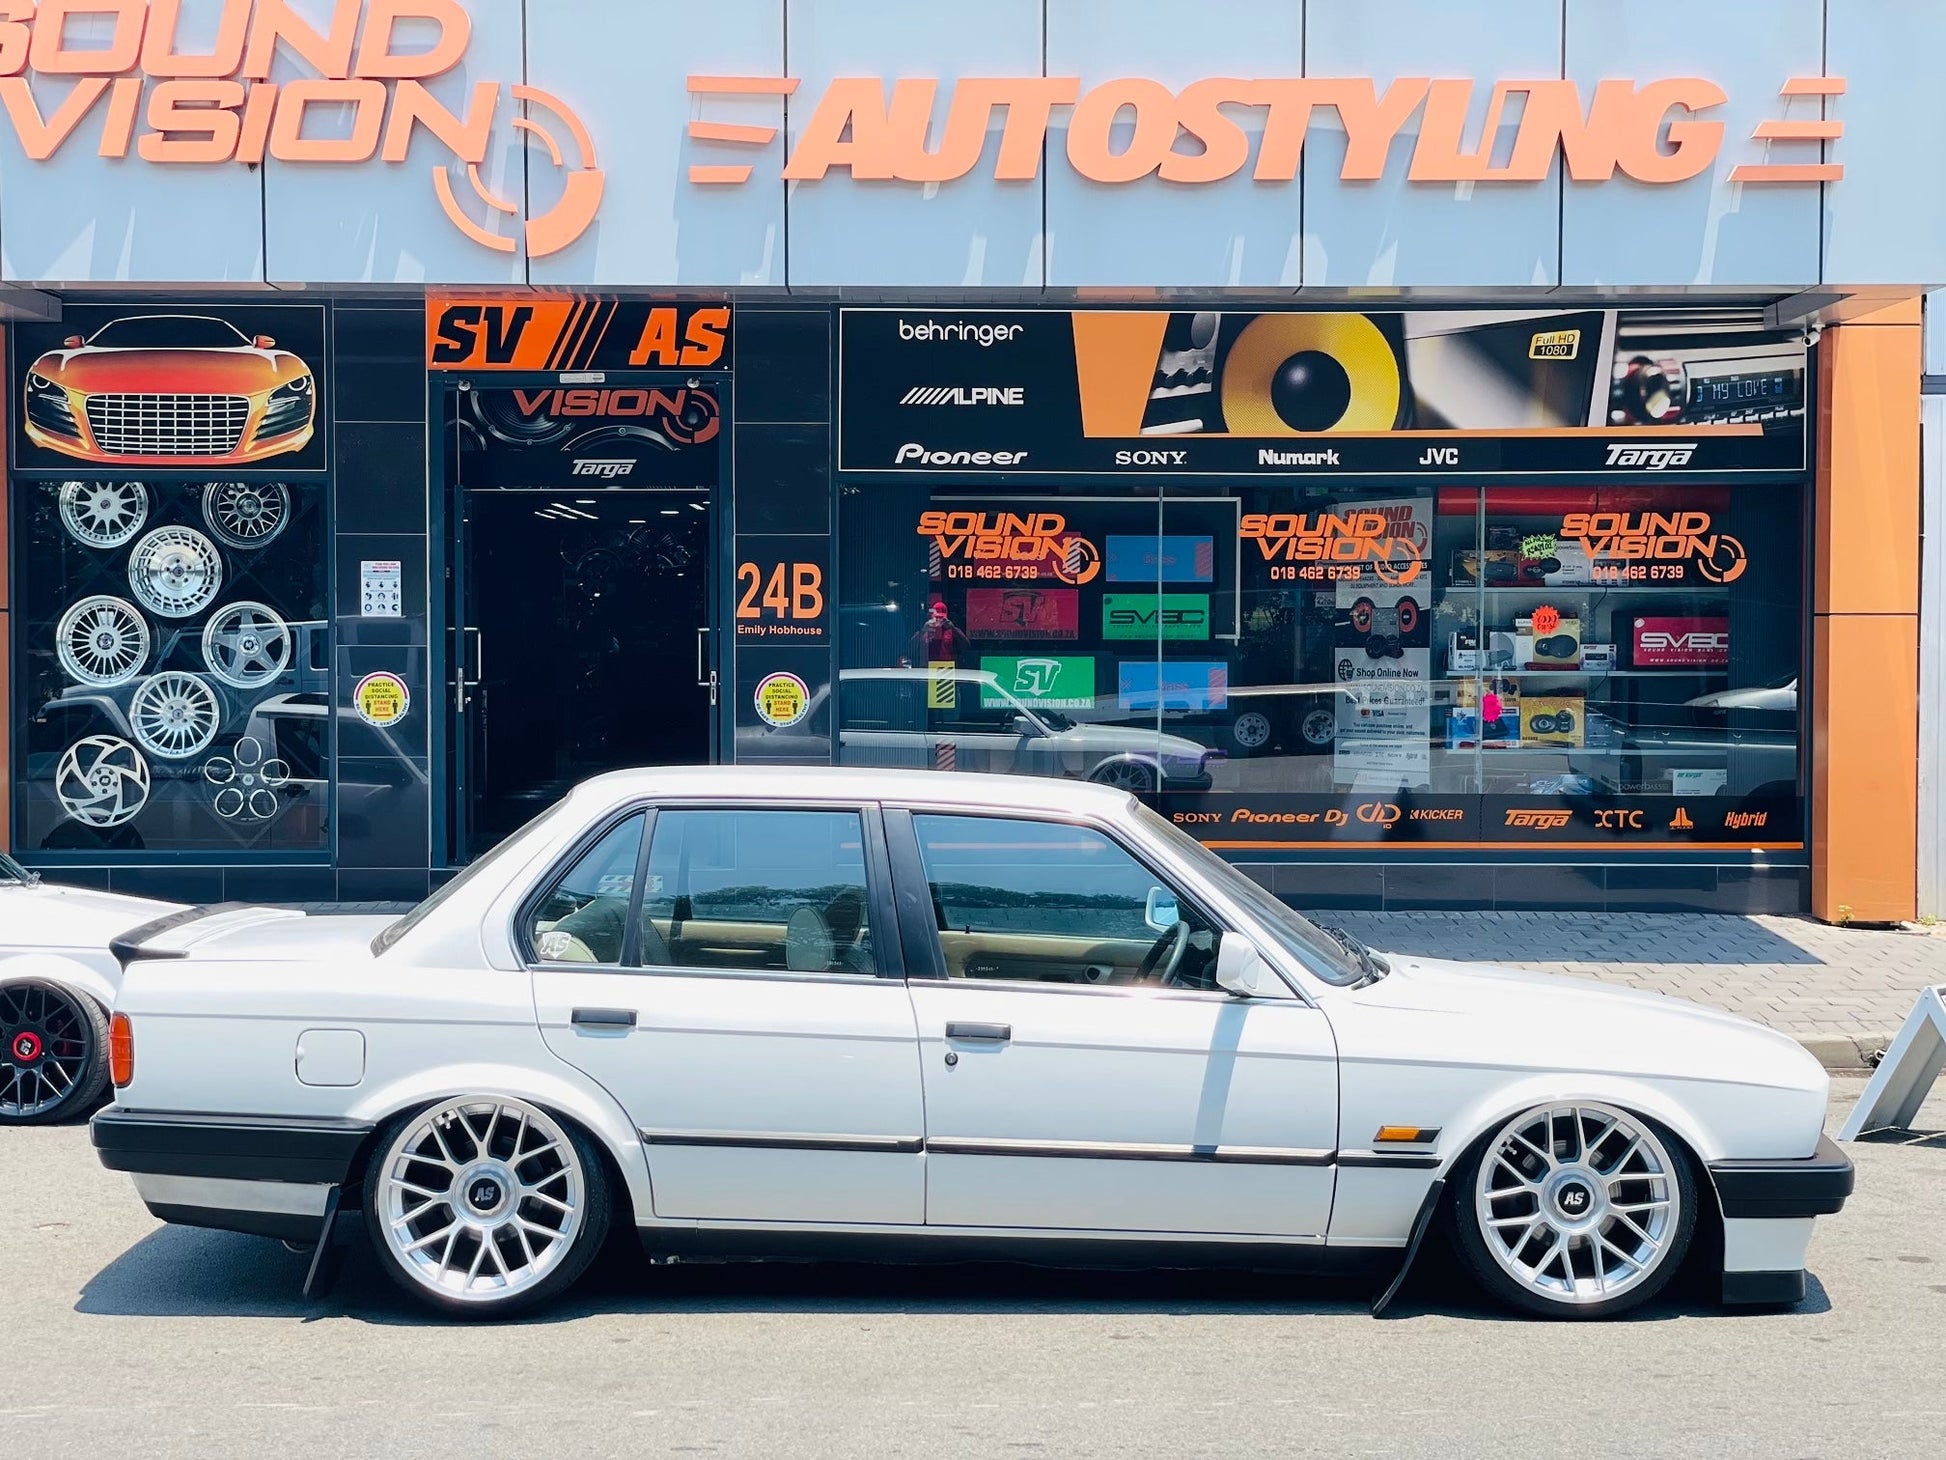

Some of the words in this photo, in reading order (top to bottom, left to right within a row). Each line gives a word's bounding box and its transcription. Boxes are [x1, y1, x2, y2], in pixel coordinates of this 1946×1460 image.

[0, 77, 500, 164] VISION
[432, 305, 534, 363] SV
[628, 307, 731, 366] AS
[899, 319, 1024, 347] behringer
[1536, 336, 1555, 345] Full
[1559, 333, 1576, 344] HD
[1540, 345, 1568, 356] 1080
[512, 389, 687, 416] VISION
[900, 387, 1024, 405] ALPINE
[894, 442, 1028, 466] Pioneer
[1115, 450, 1186, 465] SONY
[1258, 448, 1340, 466] Numark
[1419, 447, 1459, 465] JVC
[1605, 442, 1698, 470] Targa
[572, 458, 637, 479] Targa
[917, 511, 1066, 537] SOUND
[1239, 513, 1387, 537] SOUND
[1560, 511, 1711, 536] SOUND
[935, 536, 1072, 560] VISION
[1256, 537, 1394, 560] VISION
[1579, 535, 1718, 559] VISION
[948, 565, 973, 579] 018
[976, 566, 1001, 579] 462
[1005, 566, 1038, 579] 6739
[1270, 566, 1296, 580] 018
[1299, 566, 1324, 580] 462
[1327, 566, 1361, 581] 6739
[1592, 565, 1618, 579] 018
[1622, 566, 1647, 579] 462
[1650, 566, 1684, 579] 6739
[736, 562, 823, 619] 24B
[737, 625, 766, 637] Emily
[769, 625, 822, 635] Hobhouse
[1013, 661, 1062, 692] SV
[1356, 667, 1376, 679] Shop
[1377, 667, 1402, 677] Online
[1403, 668, 1419, 678] Now
[1173, 812, 1222, 823] SONY
[1230, 808, 1319, 824] Pioneer
[1418, 809, 1464, 820] KICKER
[1504, 808, 1573, 830] Targa
[1724, 811, 1768, 829] Hybrid
[1564, 1191, 1585, 1206] AS
